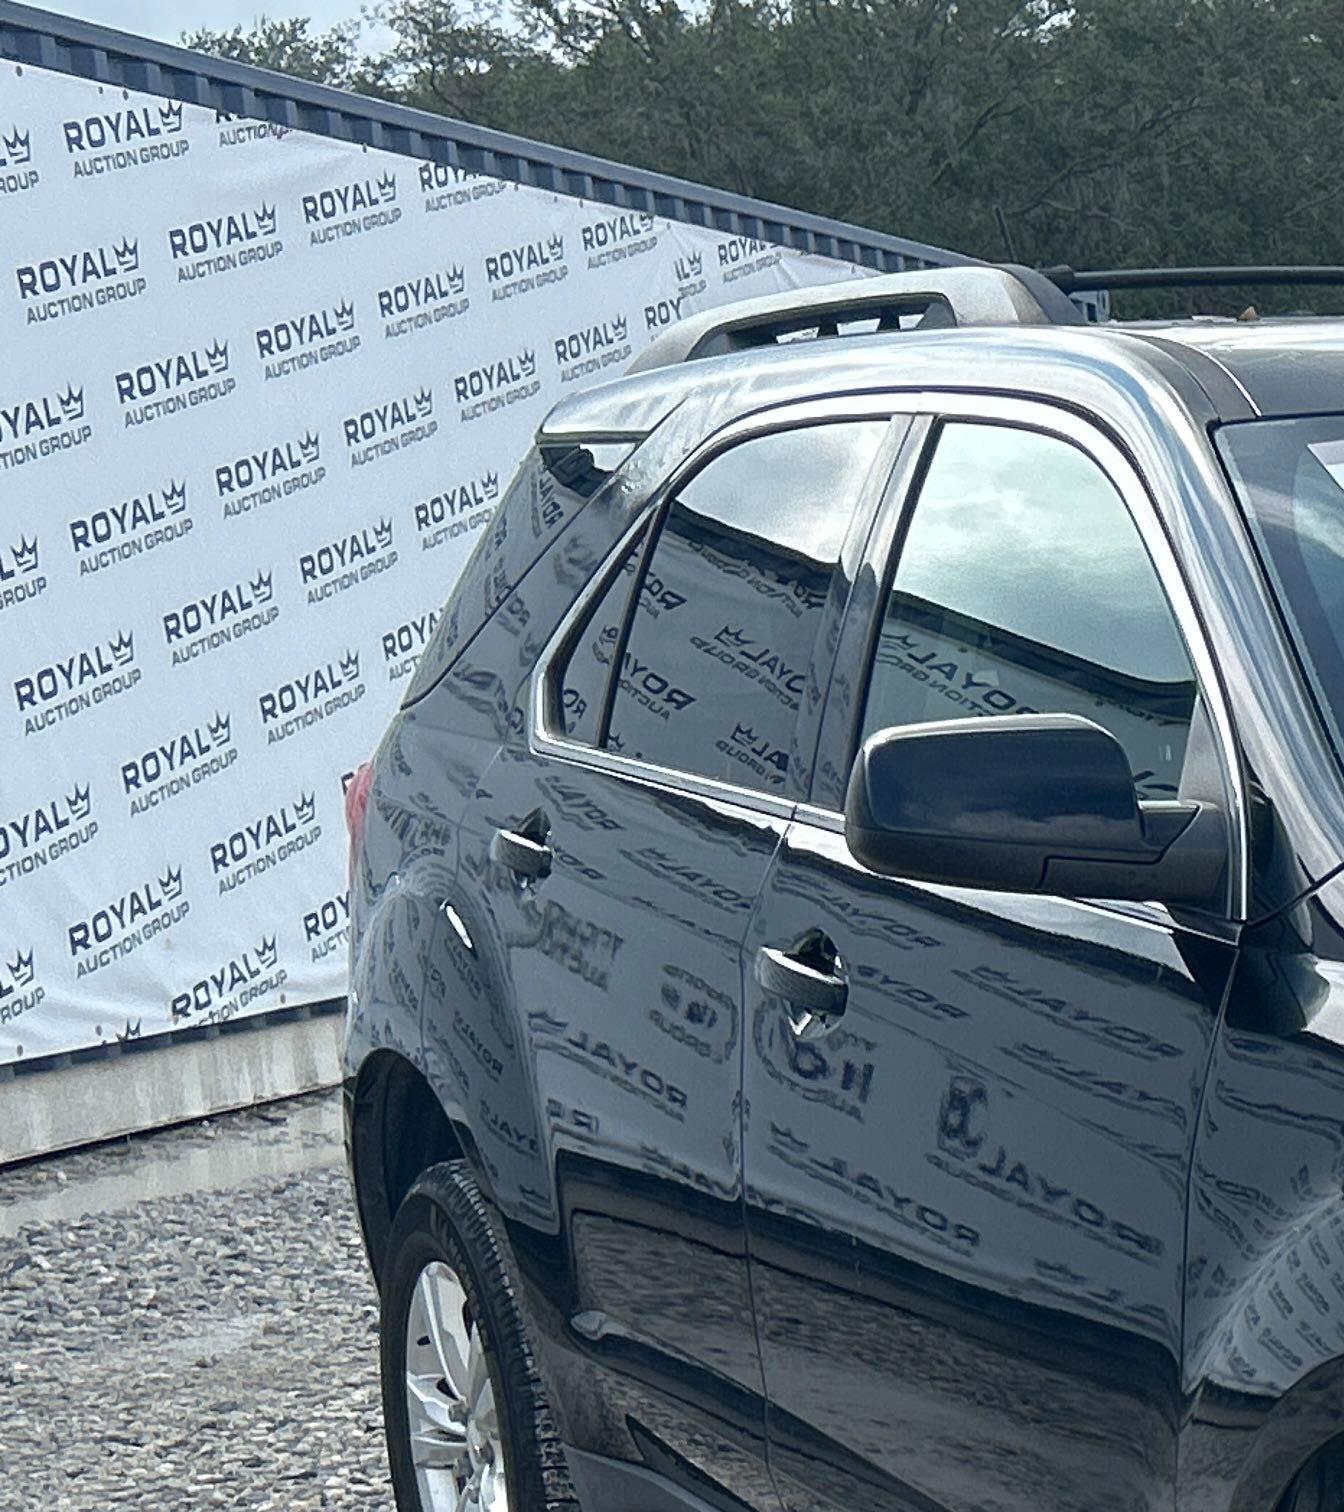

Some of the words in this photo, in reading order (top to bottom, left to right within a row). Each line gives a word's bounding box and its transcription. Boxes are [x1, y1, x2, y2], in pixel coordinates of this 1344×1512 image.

[63, 108, 161, 153] ROYAL
[219, 123, 279, 148] AUCTION
[0, 170, 39, 194] ROUP
[73, 150, 138, 178] AUCTION
[139, 139, 190, 164] GROUP
[302, 180, 379, 223] ROYAL
[169, 212, 258, 259] ROYAL
[310, 218, 361, 246] AUCTION
[362, 207, 402, 230] GROUP
[582, 214, 641, 251] ROYAL
[16, 247, 117, 299] ROYAL
[178, 254, 237, 282] AUCTION
[239, 241, 283, 266] GROUP
[485, 242, 549, 283] ROYAL
[491, 278, 535, 302] AUCTION
[536, 265, 568, 287] GROUP
[27, 294, 95, 325] AUCTION
[96, 277, 147, 305] GROUP
[378, 274, 449, 318] ROYAL
[385, 312, 433, 338] AUCTION
[433, 298, 470, 322] GROUP
[644, 297, 681, 330] ROY
[256, 310, 337, 358] ROYAL
[264, 350, 319, 380] AUCTION
[320, 335, 361, 361] GROUP
[555, 322, 613, 364] ROYAL
[115, 351, 209, 404] ROYAL
[454, 358, 521, 403] ROYAL
[561, 358, 601, 382] AUCTION
[0, 397, 61, 441] YAL
[124, 393, 187, 428] AUCTION
[189, 377, 236, 406] GROUP
[343, 398, 417, 446] ROYAL
[460, 394, 505, 422] AUCTION
[506, 380, 540, 405] GROUP
[39, 425, 92, 456] GROUP
[351, 435, 399, 467] AUCTION
[400, 421, 438, 448] GROUP
[215, 442, 301, 496] ROYAL
[223, 484, 282, 519] AUCTION
[283, 466, 326, 496] GROUP
[70, 493, 165, 552] ROYAL
[414, 481, 484, 531] ROYAL
[422, 519, 468, 551] AUCTION
[468, 508, 493, 530] GRO
[80, 538, 143, 576] AUCTION
[144, 518, 193, 550] GROUP
[299, 529, 376, 584] ROYAL
[0, 576, 47, 607] ROUP
[307, 569, 359, 604] AUCTION
[360, 550, 398, 581] GROUP
[163, 584, 252, 644] ROYAL
[171, 627, 232, 667] AUCTION
[232, 605, 280, 639] GROUP
[14, 645, 113, 711] ROYAL
[259, 664, 342, 724] ROYAL
[24, 692, 91, 736] AUCTION
[91, 668, 142, 704] GROUP
[268, 706, 324, 745] AUCTION
[324, 683, 366, 717] GROUP
[121, 728, 210, 794] ROYAL
[130, 769, 191, 817] AUCTION
[192, 748, 238, 784] GROUP
[48, 821, 98, 860] GROUP
[209, 807, 297, 873] ROYAL
[218, 850, 277, 896] AUCTION
[277, 825, 322, 861] GROUP
[68, 883, 162, 955] ROYAL
[303, 890, 350, 941] ROY
[77, 929, 143, 979] AUCTION
[142, 901, 190, 940] GROUP
[0, 986, 45, 1023] ROUP
[171, 953, 261, 1019] ROYAL
[239, 968, 287, 1008] GROUP
